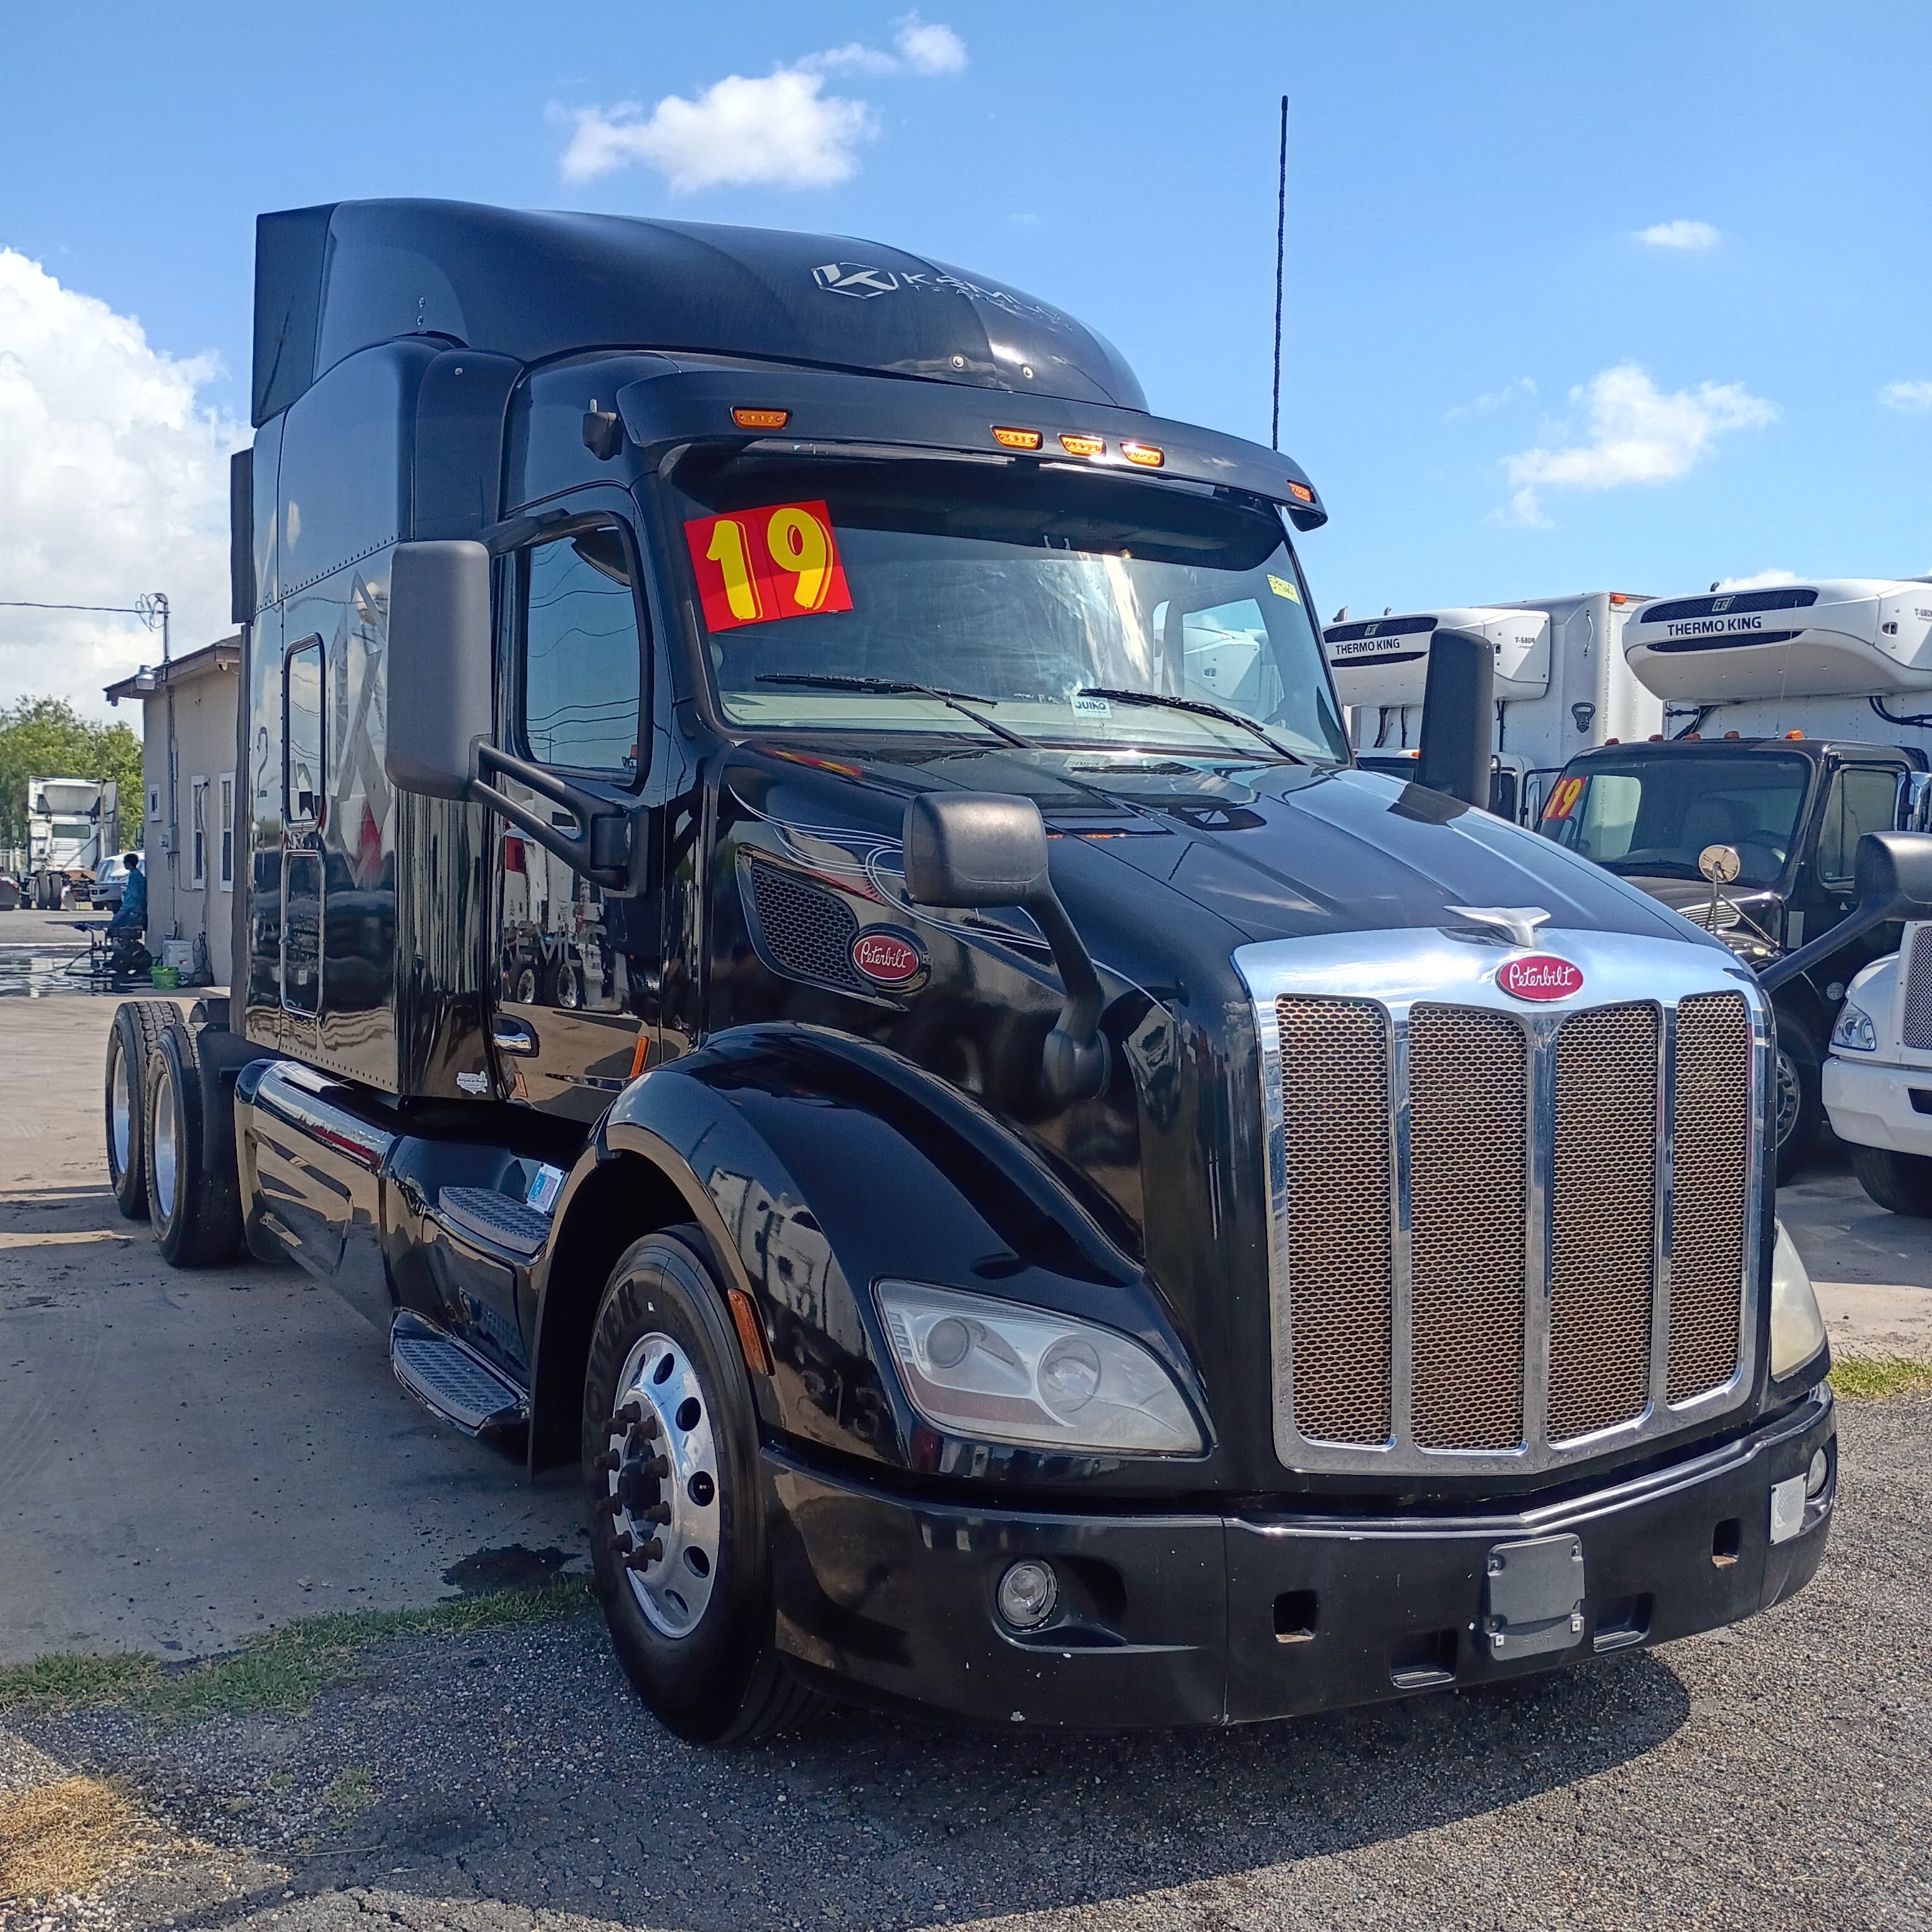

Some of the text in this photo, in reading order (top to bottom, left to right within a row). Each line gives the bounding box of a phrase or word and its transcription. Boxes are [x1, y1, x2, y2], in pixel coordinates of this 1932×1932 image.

[706, 508, 833, 619] 19
[1667, 616, 1762, 636] THERMO KING
[1335, 638, 1400, 655] THERMO KING
[1547, 778, 1582, 817] 19
[861, 941, 911, 969] Peterbilt
[1509, 963, 1575, 989] Peterbilt
